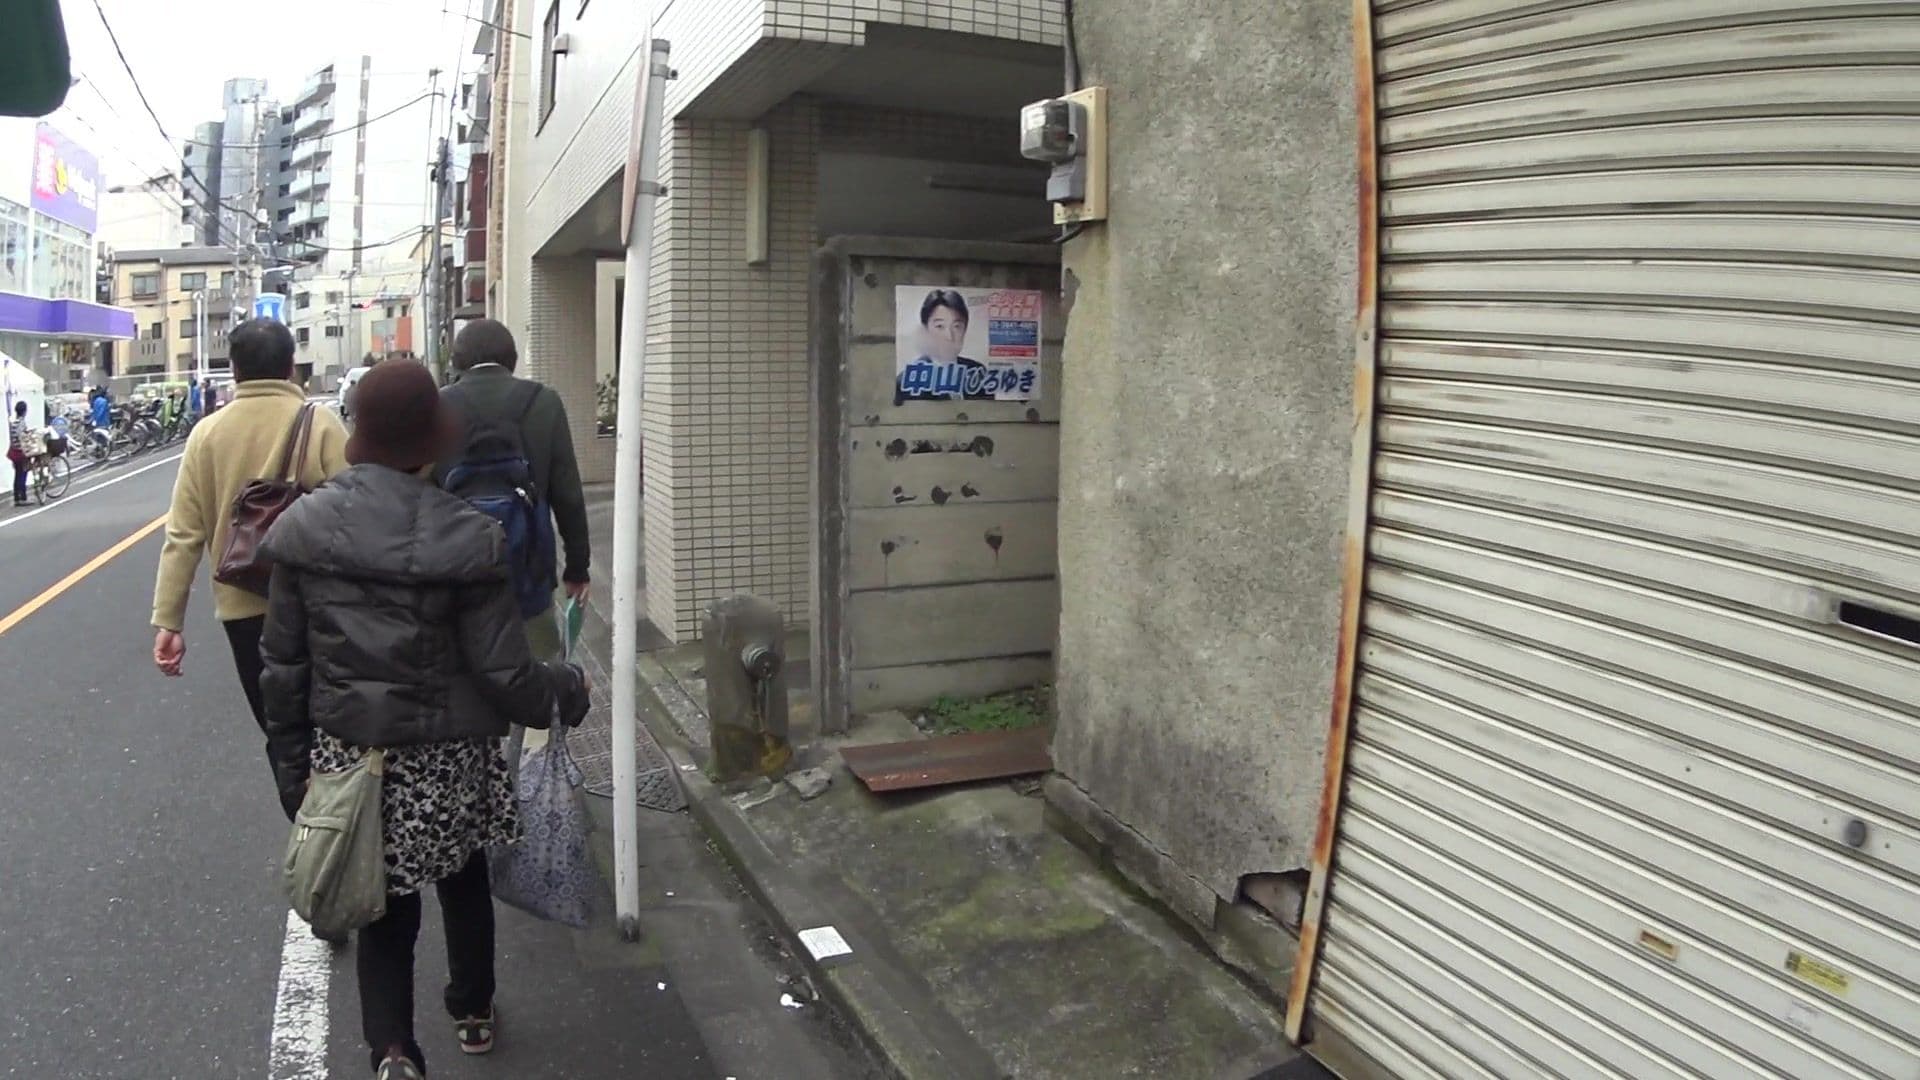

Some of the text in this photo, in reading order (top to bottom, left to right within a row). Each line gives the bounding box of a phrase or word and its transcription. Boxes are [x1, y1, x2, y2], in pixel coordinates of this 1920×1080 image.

[902, 361, 1035, 394] 中山ひろゆき
